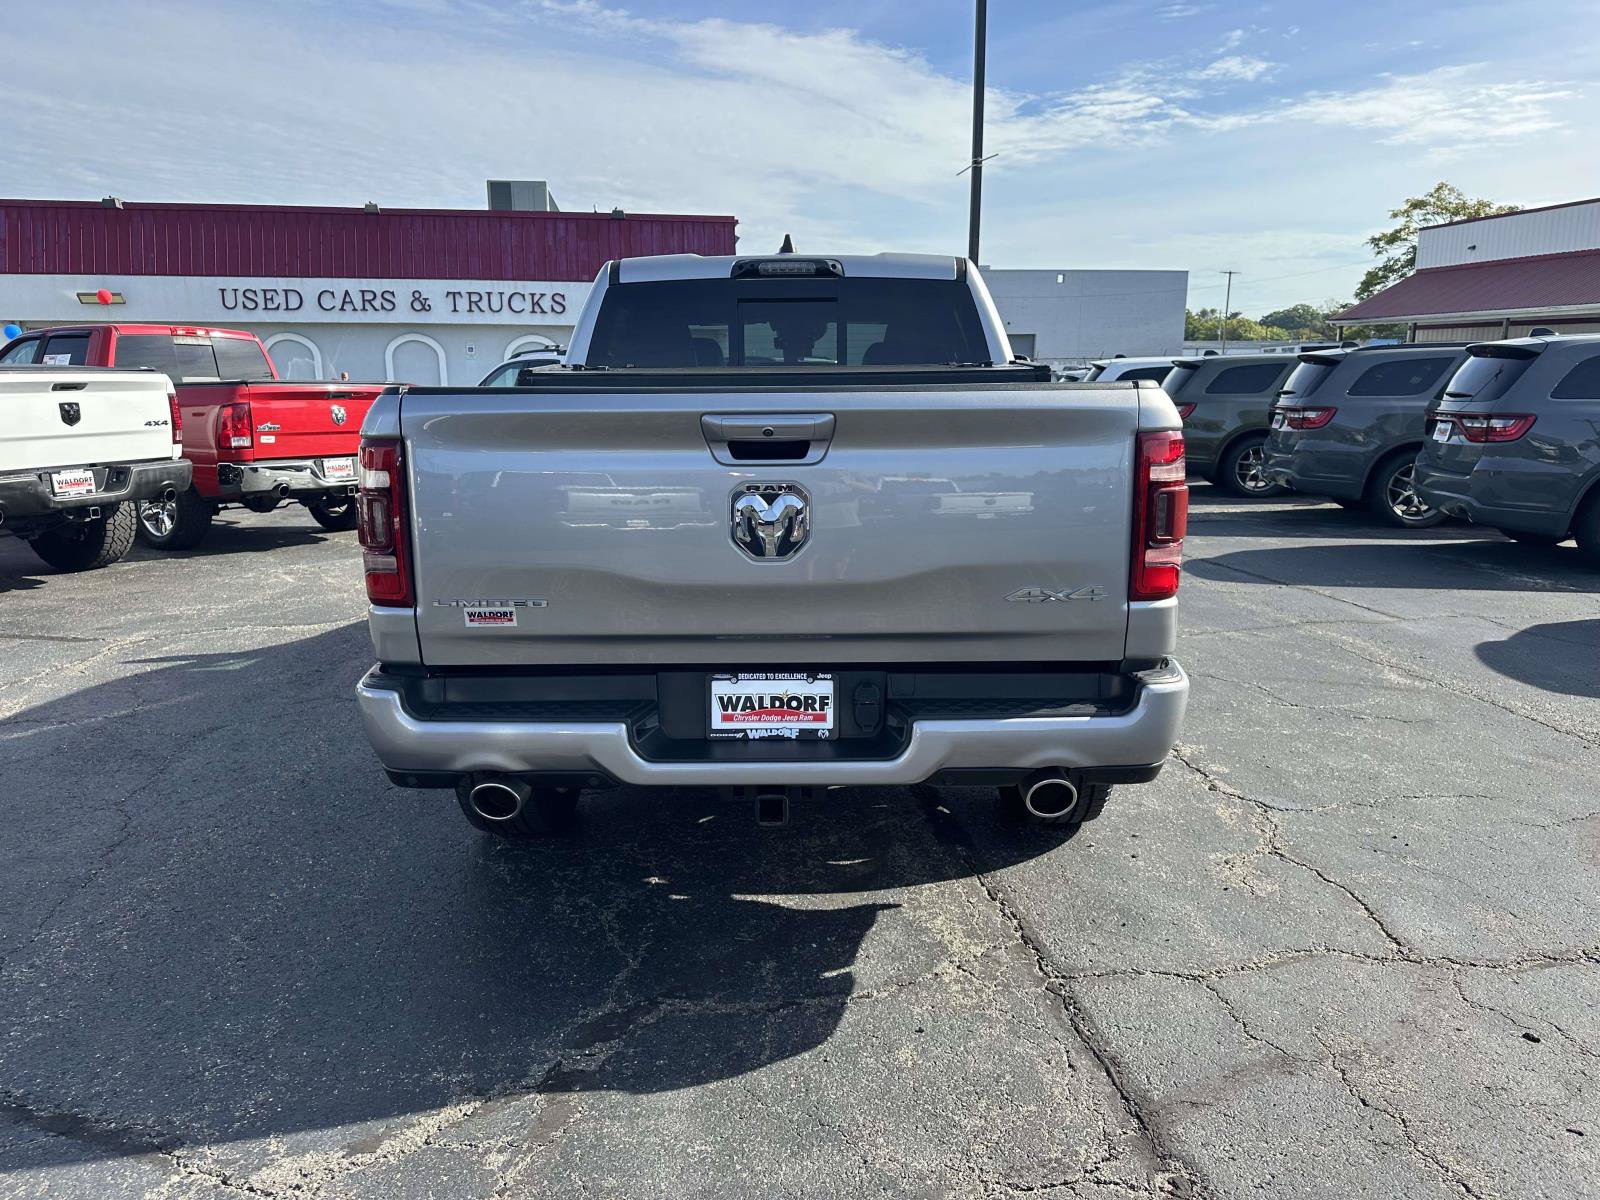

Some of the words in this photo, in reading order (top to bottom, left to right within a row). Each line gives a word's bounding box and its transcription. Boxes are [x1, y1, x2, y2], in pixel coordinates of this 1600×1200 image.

[218, 288, 304, 311] USED
[316, 289, 397, 312] CARS
[410, 290, 432, 312] &
[445, 290, 567, 314] TRUCKS
[56, 477, 92, 486] WALDORF
[745, 484, 793, 492] RAM
[432, 599, 549, 608] LIMITED
[466, 611, 514, 619] WALDORF
[716, 694, 832, 712] WALDORF
[733, 714, 760, 722] Chrysler
[761, 714, 781, 722] Dodge
[782, 714, 798, 722] Jeep
[746, 728, 799, 739] WALDORF
